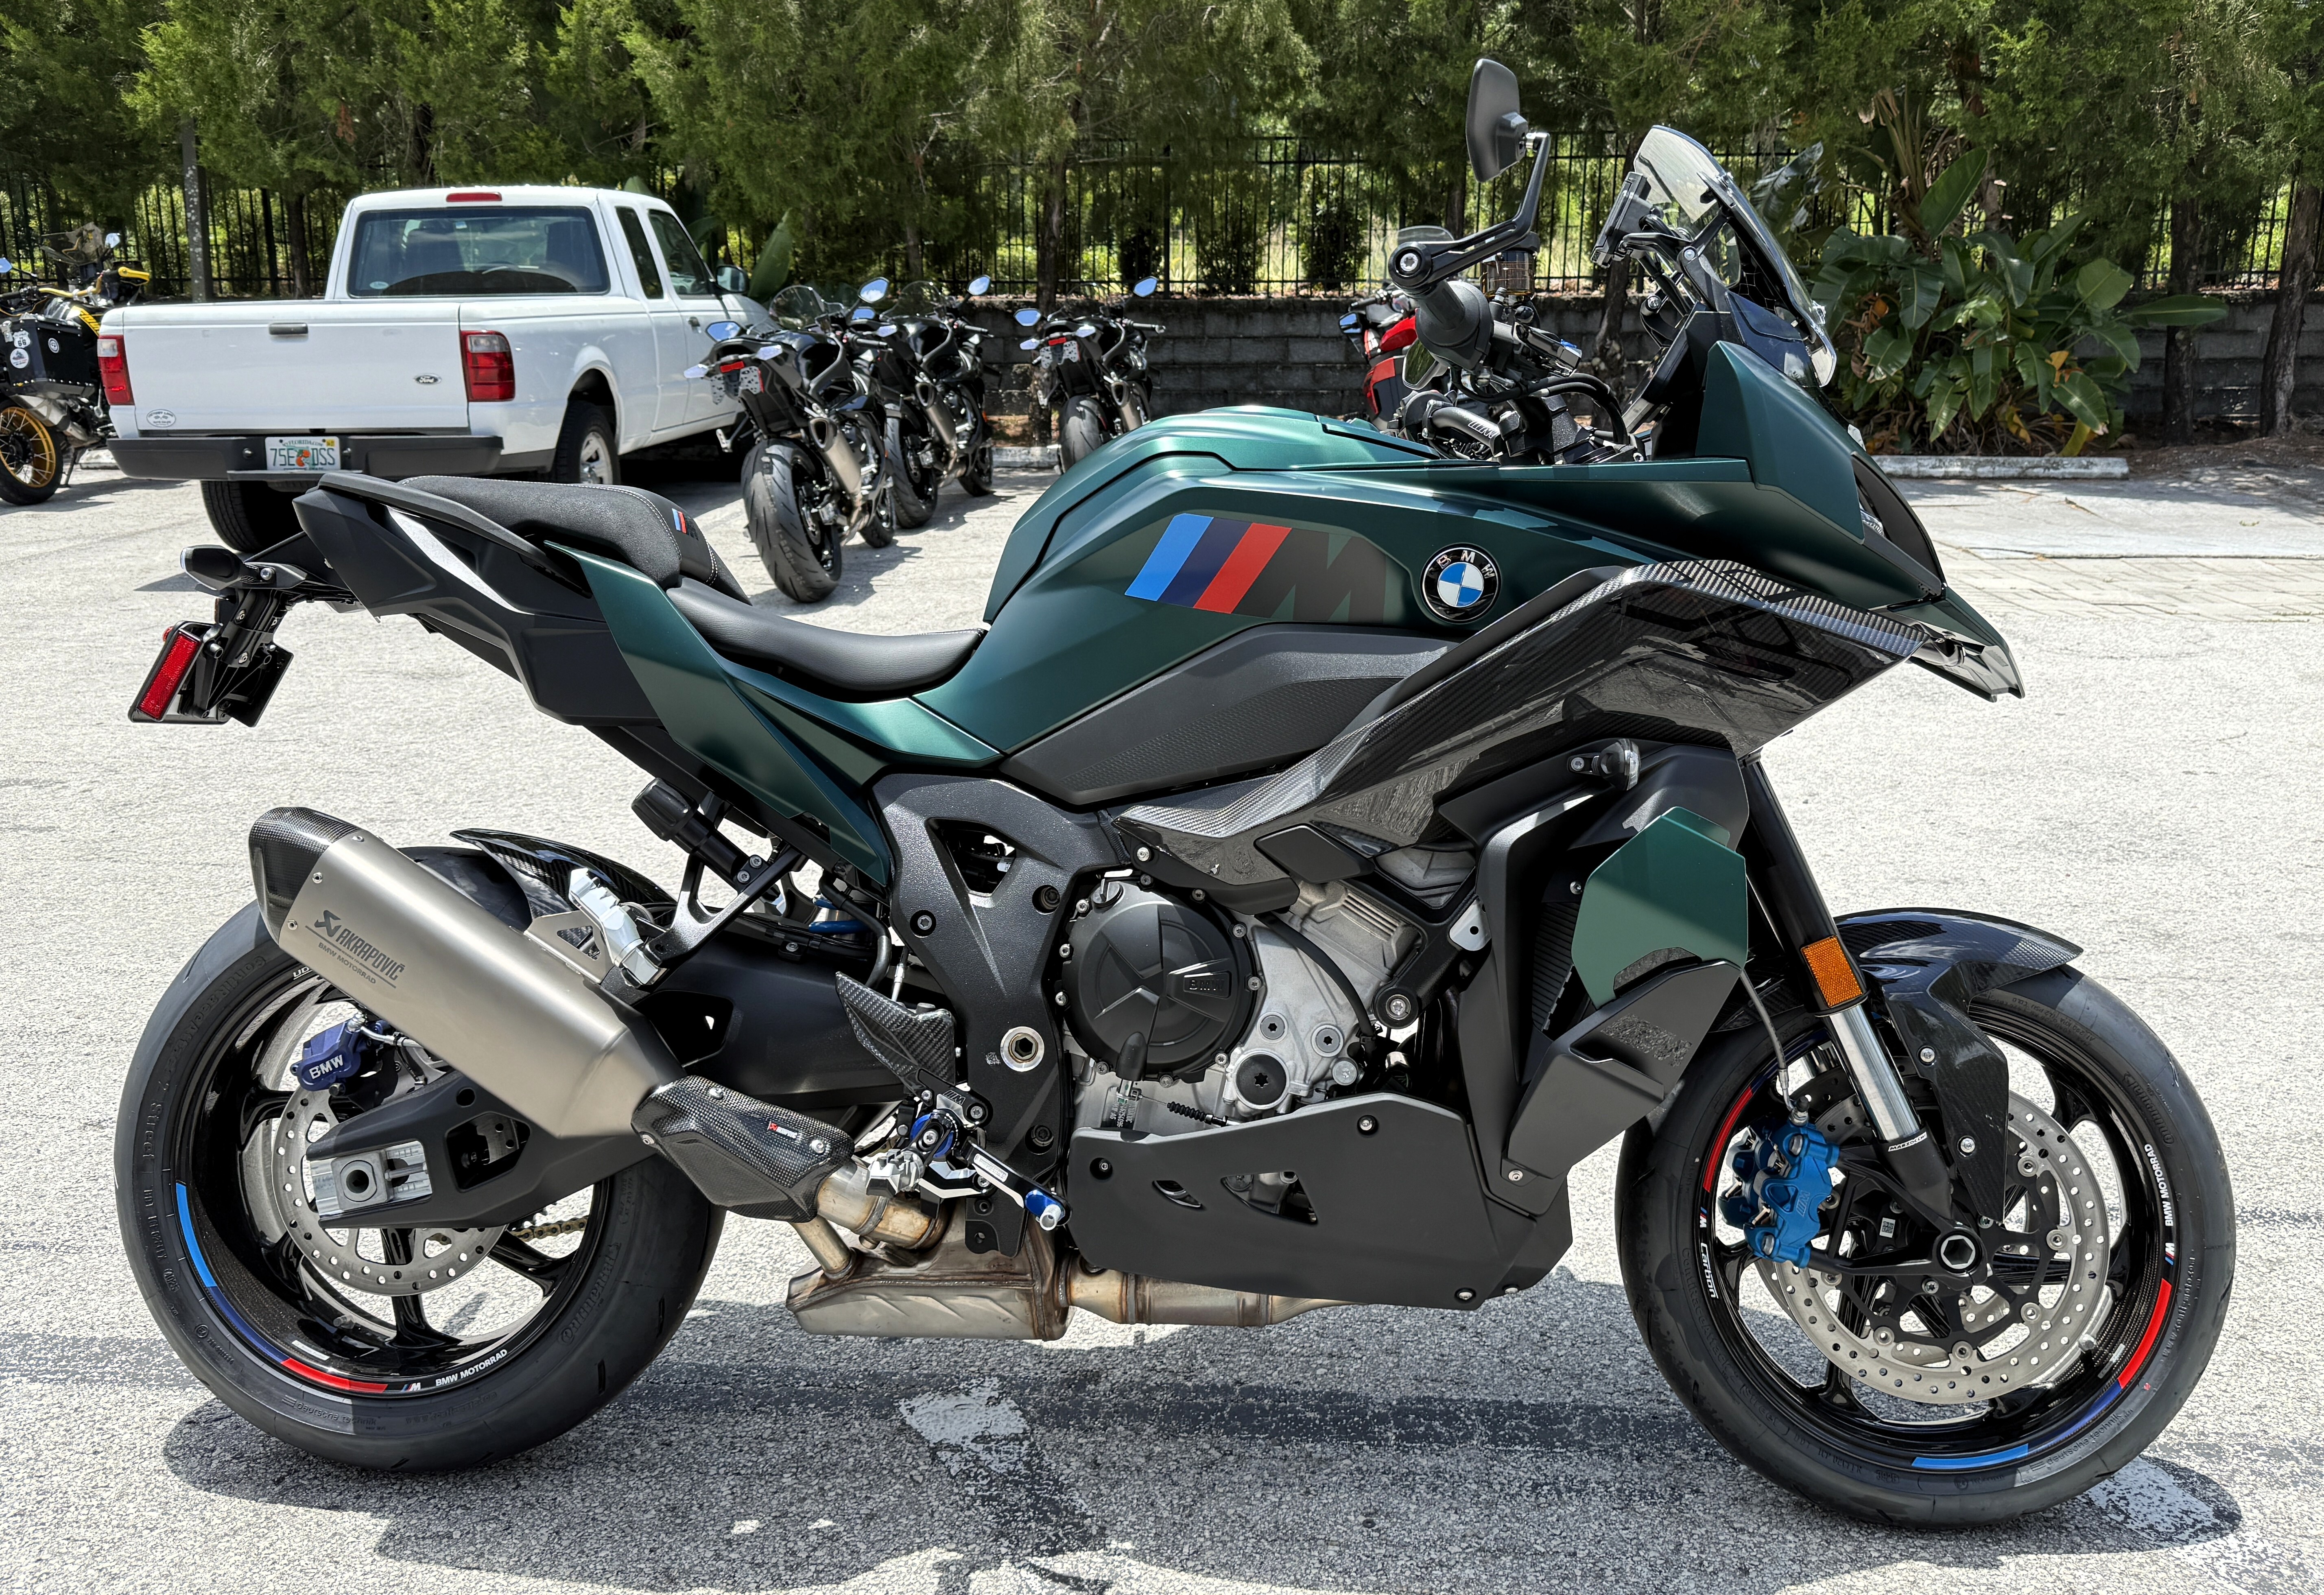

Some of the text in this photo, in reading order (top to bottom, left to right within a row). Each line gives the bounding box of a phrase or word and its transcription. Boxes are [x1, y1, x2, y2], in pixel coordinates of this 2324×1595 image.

[270, 448, 335, 466] 75E DSS
[1437, 550, 1495, 579] BMW
[318, 942, 337, 957] BMW
[337, 955, 376, 984] MOTORRAD
[309, 1055, 343, 1079] BMW
[2144, 1144, 2169, 1198] MOTORRAD
[2163, 1201, 2173, 1226] BMW
[435, 1373, 458, 1386] BMW
[460, 1349, 507, 1379] MOTORRAD
